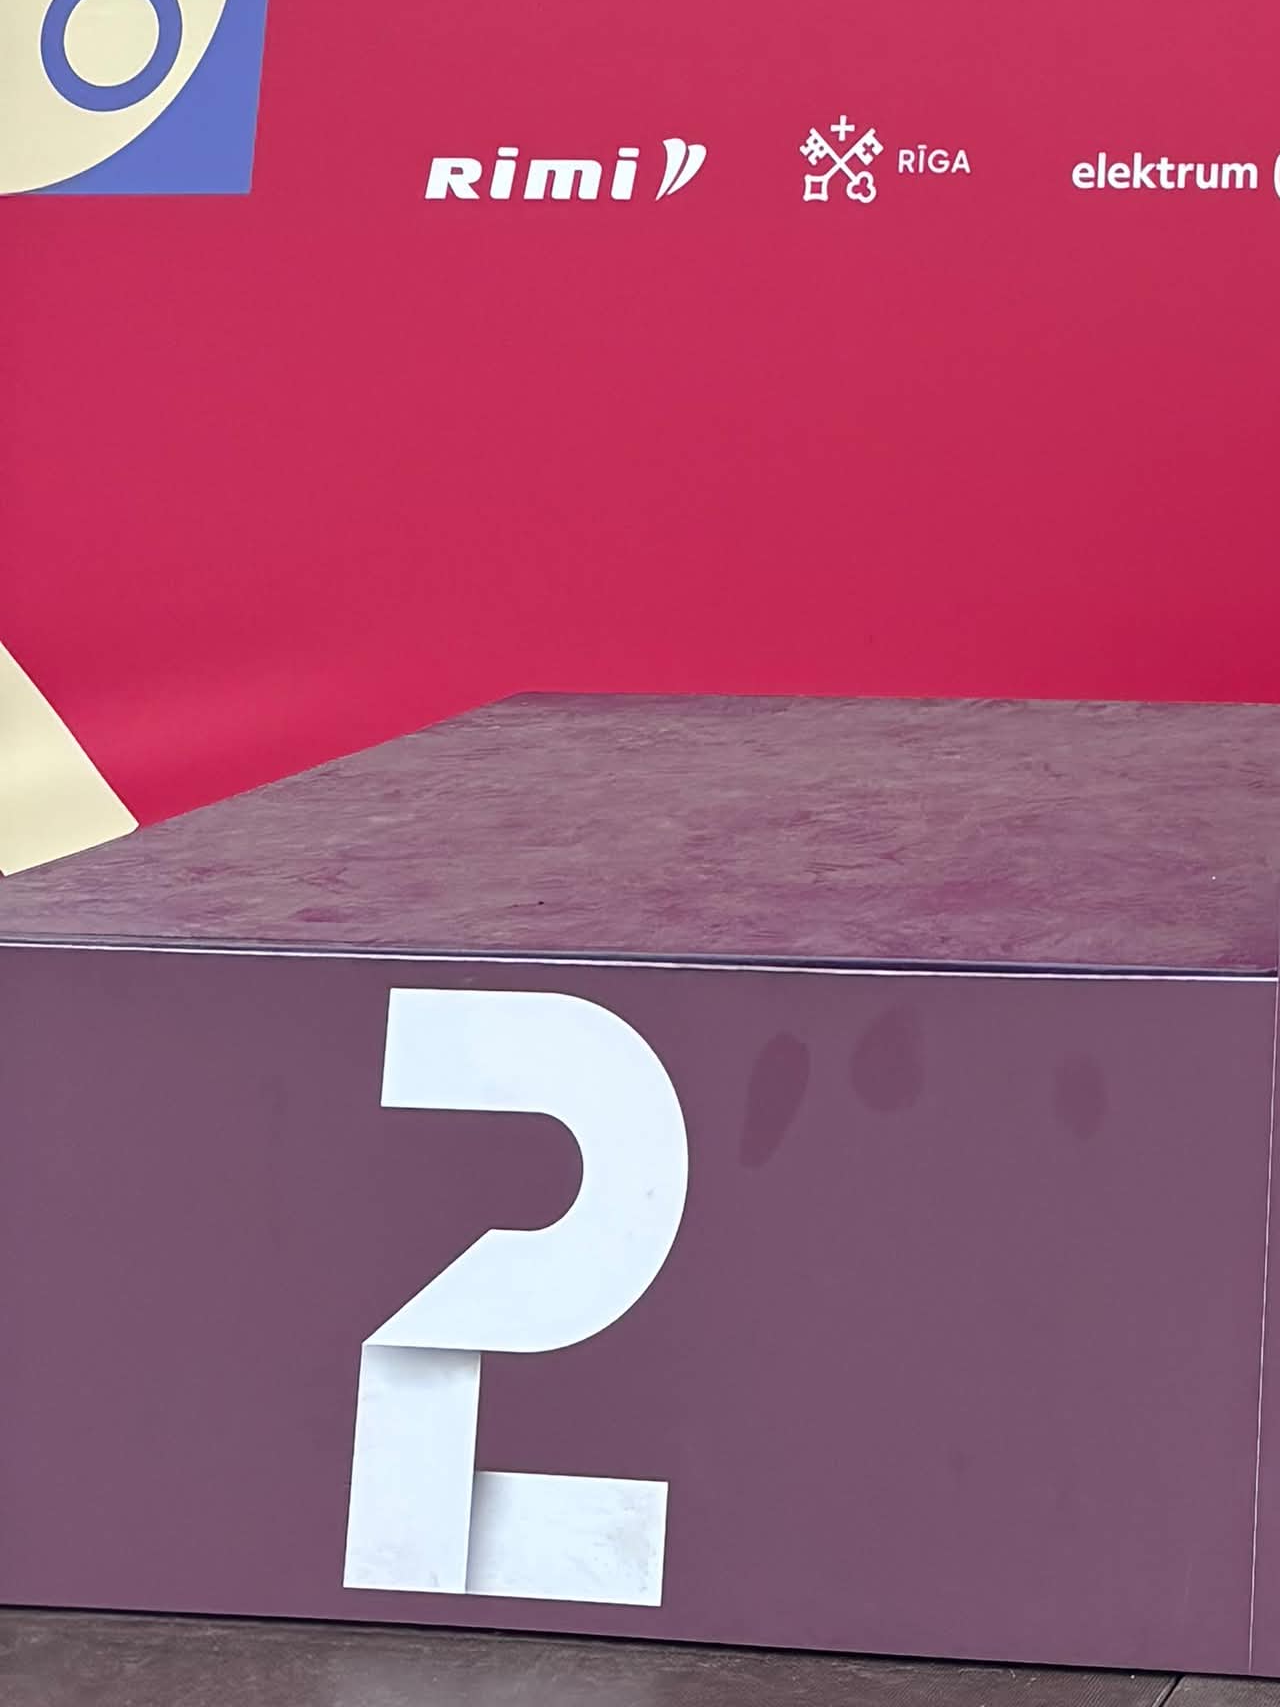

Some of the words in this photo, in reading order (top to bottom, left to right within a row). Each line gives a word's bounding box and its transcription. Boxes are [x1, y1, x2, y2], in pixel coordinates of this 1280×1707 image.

[425, 147, 639, 199] Rimi
[899, 145, 970, 173] RĪGA
[1072, 153, 1257, 189] elektrum
[343, 987, 690, 1607] 2
